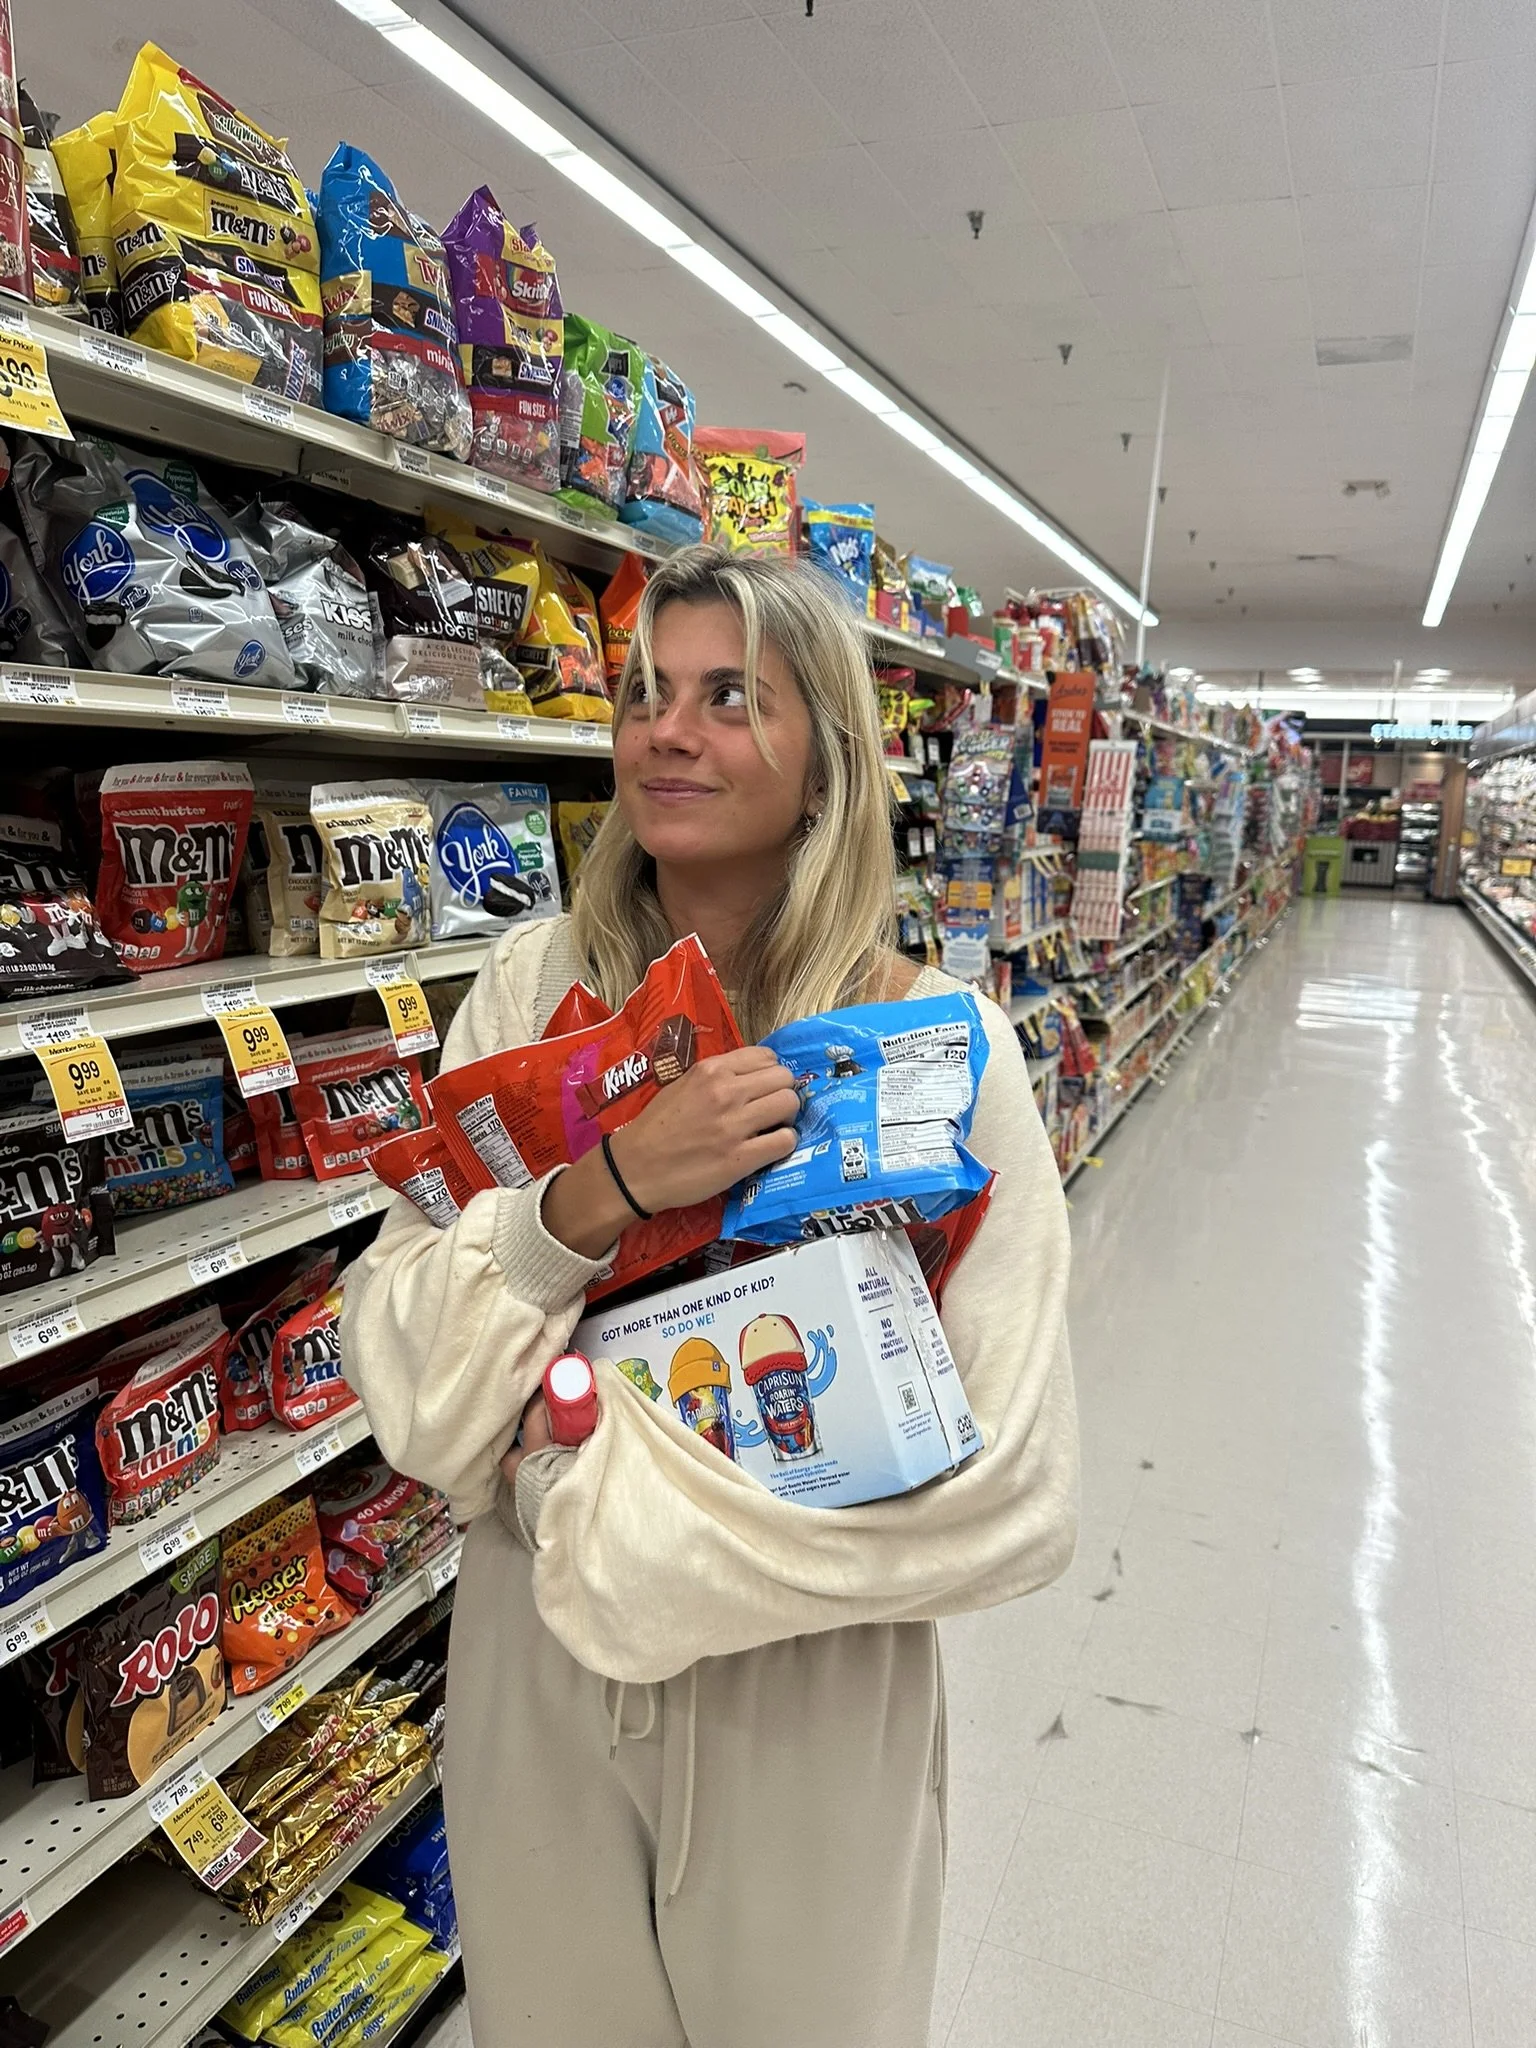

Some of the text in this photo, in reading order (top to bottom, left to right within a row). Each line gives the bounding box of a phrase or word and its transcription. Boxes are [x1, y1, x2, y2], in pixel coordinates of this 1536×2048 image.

[211, 207, 276, 247] m&m's
[249, 289, 271, 312] FUN
[13, 339, 34, 352] Price!
[519, 401, 532, 415] FUN
[63, 528, 124, 597] York
[477, 586, 523, 620] SHEY'S
[322, 600, 373, 633] KISS
[481, 612, 513, 632] iatures
[285, 620, 313, 638] ses
[337, 631, 357, 643] milk
[1052, 720, 1083, 732] REAL
[176, 772, 184, 783] &
[508, 787, 539, 798] FAMILY
[160, 806, 206, 816] butter
[326, 814, 375, 830] almond
[441, 824, 511, 907] York
[398, 996, 418, 1019] 999
[242, 1025, 270, 1053] 999
[882, 1024, 966, 1049] Nutrition Facts
[49, 1045, 77, 1056] Member
[943, 1049, 967, 1060] 120
[68, 1060, 100, 1091] 999
[277, 1067, 291, 1076] OFF
[602, 1050, 650, 1101] KitKat
[108, 1108, 124, 1119] OFF
[475, 1095, 493, 1111] Facts
[104, 1100, 205, 1157] &m's
[487, 1118, 501, 1133] 170
[104, 1145, 188, 1181] minis
[0, 1147, 83, 1222] &m's
[421, 1169, 441, 1180] Facts
[432, 1187, 448, 1203] 170
[346, 1203, 360, 1218] 699
[210, 1258, 227, 1274] 699
[865, 1266, 878, 1278] ALL
[858, 1276, 890, 1293] NATURAL
[861, 1287, 893, 1303] INGREDIENTS
[601, 1276, 776, 1343] GOT MORE THAN ONE KIND OF KID?
[662, 1312, 716, 1339] SO DO WE!
[880, 1317, 892, 1330] NO
[883, 1329, 896, 1339] HIGH
[38, 1325, 59, 1344] 699
[880, 1350, 895, 1361] CORN
[769, 1388, 796, 1402] ROARIN'
[115, 1365, 218, 1469] m&m's
[765, 1396, 804, 1420] WATERS
[139, 1419, 210, 1480] minis
[313, 1444, 329, 1462] 699
[0, 1434, 80, 1528] &m's
[356, 1479, 409, 1521] 40 FLAVORS
[163, 1535, 181, 1556] 699
[441, 1561, 454, 1580] 699
[228, 1553, 310, 1625] Reese's
[6, 1630, 28, 1653] 699
[275, 1696, 292, 1716] 799
[170, 1784, 189, 1806] 799
[173, 1788, 211, 1825] Member Price!
[210, 1810, 229, 1833] 699
[183, 1829, 204, 1855] 749
[211, 1855, 229, 1876] PICK
[289, 1901, 304, 1924] 599
[284, 1951, 335, 2009] Butterfinger
[351, 1927, 367, 1945] Size
[375, 1957, 392, 1978] Size
[235, 1965, 282, 2006] Butterfinger
